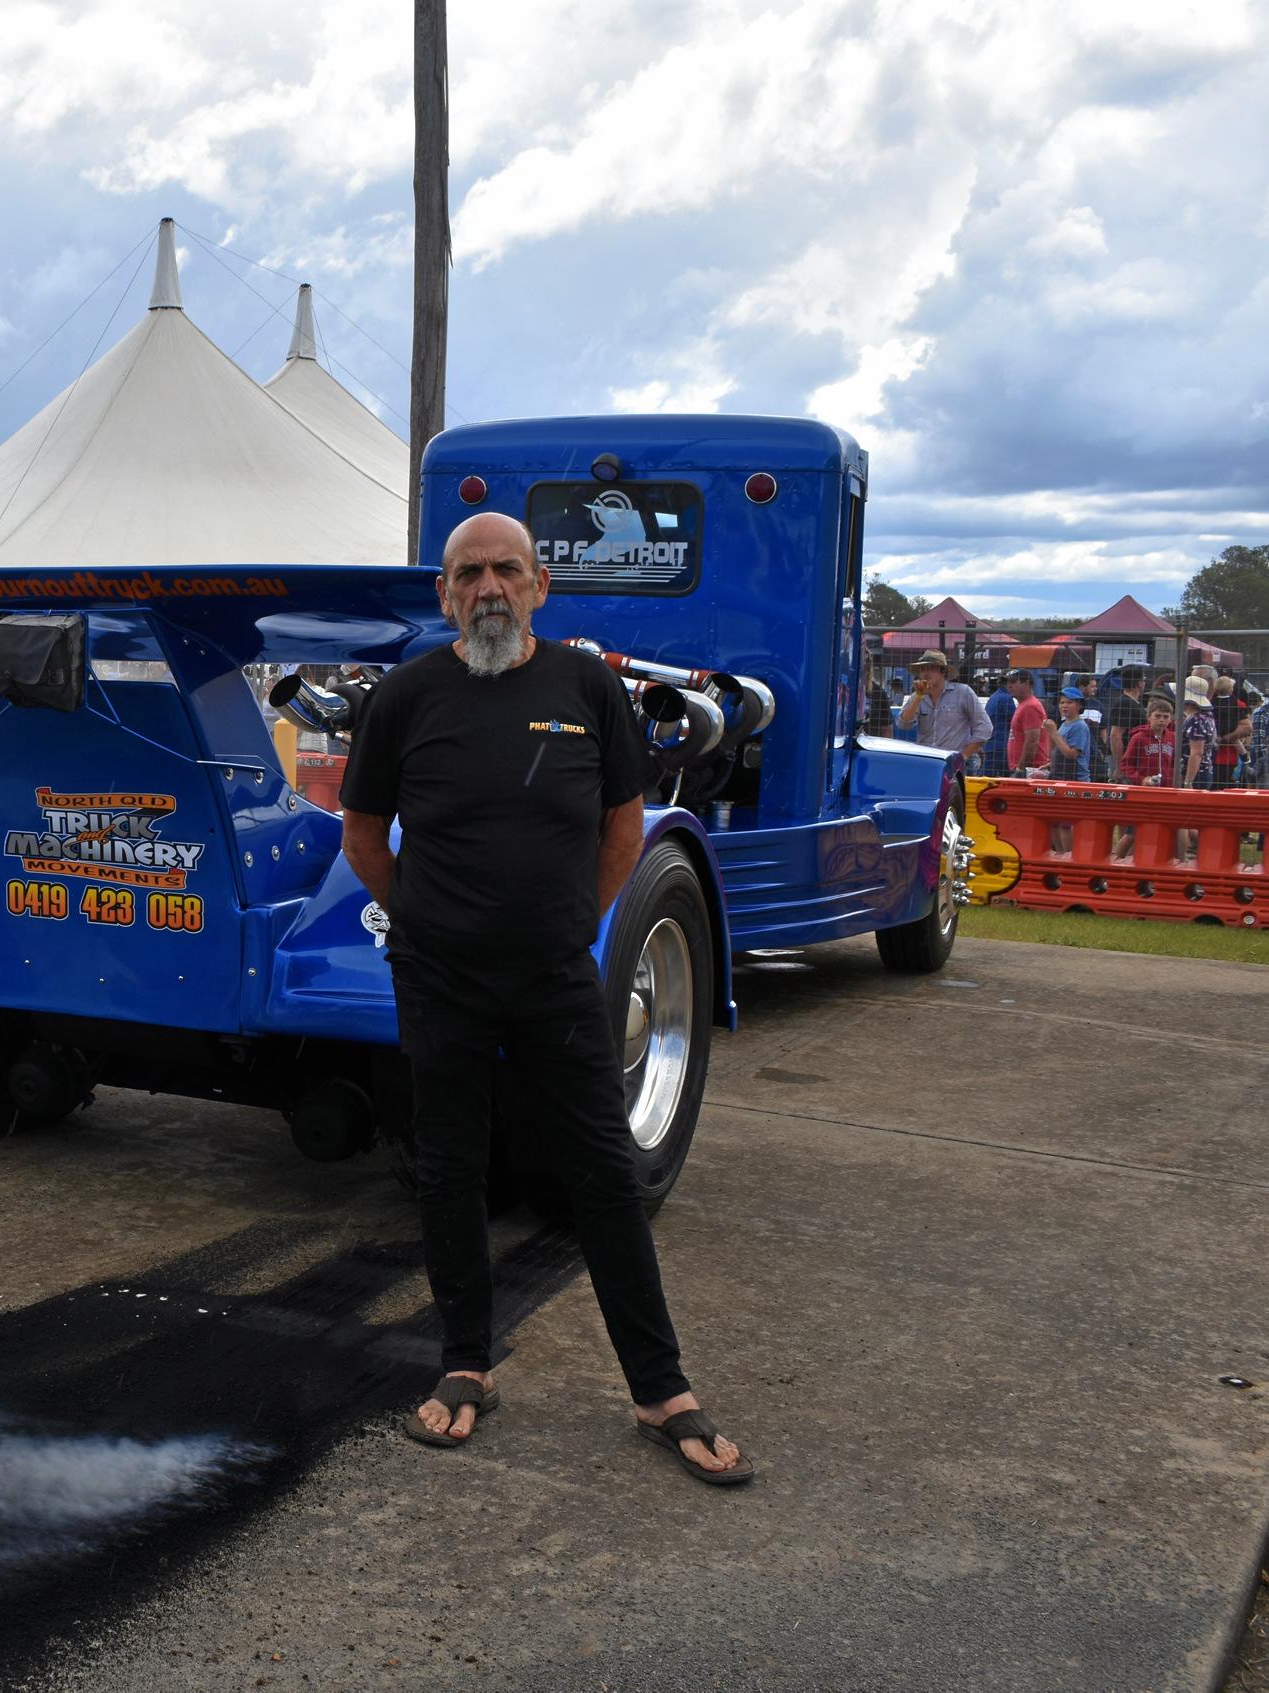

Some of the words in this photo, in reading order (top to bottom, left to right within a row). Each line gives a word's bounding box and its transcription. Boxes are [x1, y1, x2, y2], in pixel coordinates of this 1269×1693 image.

[597, 541, 688, 566] DETROIT
[529, 722, 550, 731] PHAT
[560, 723, 586, 734] TRUCKS
[41, 795, 112, 807] NORTH
[120, 795, 168, 807] QLD
[43, 809, 158, 841] TRUCK
[27, 860, 182, 887] MOVEMENTS
[7, 880, 68, 919] 0419
[81, 886, 135, 925] 423
[148, 892, 203, 932] 058
